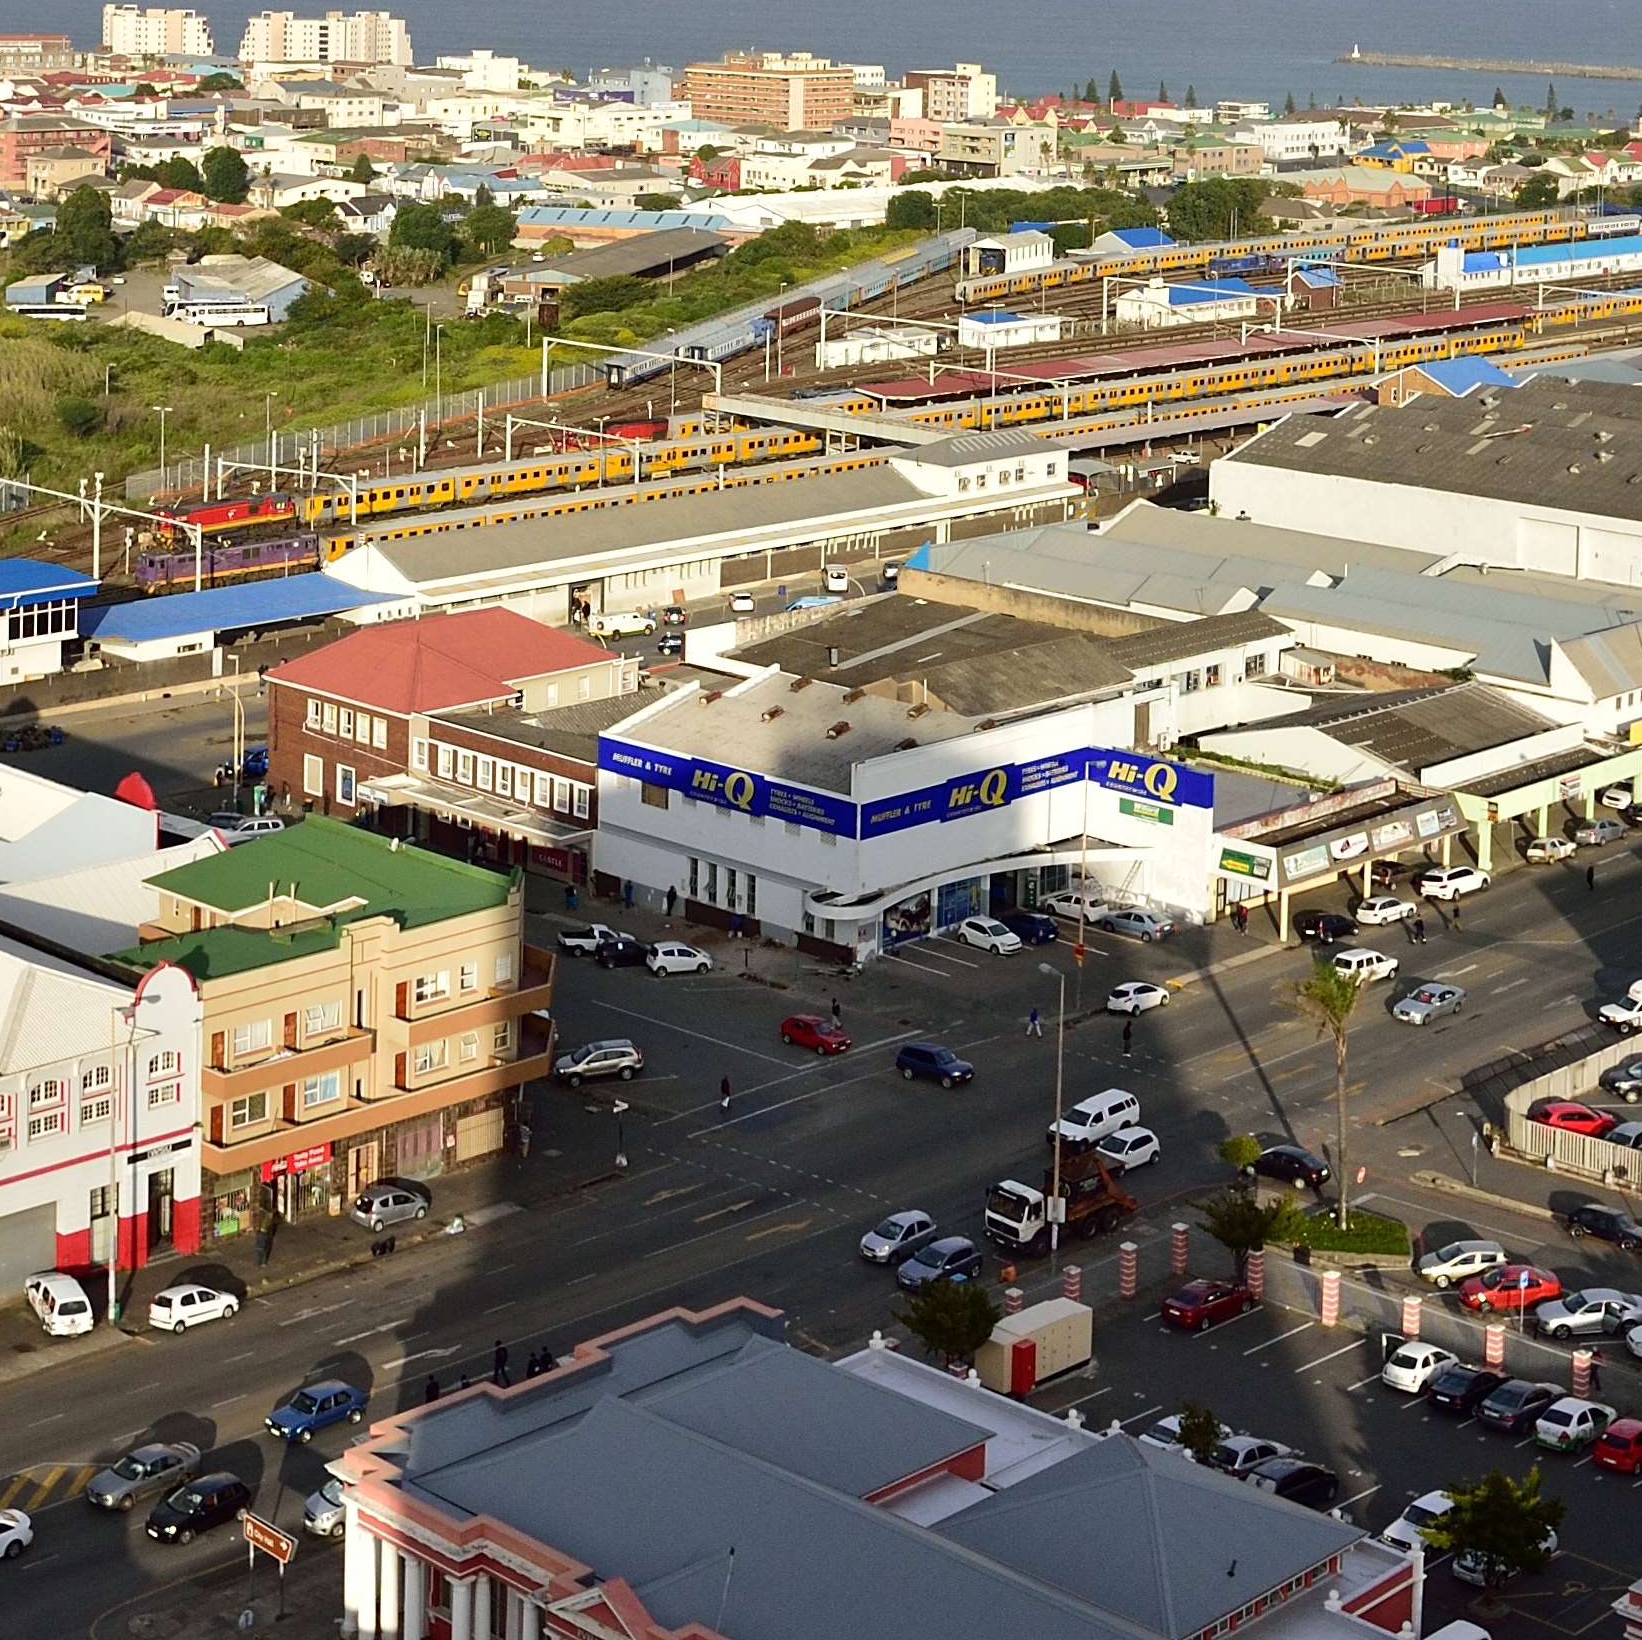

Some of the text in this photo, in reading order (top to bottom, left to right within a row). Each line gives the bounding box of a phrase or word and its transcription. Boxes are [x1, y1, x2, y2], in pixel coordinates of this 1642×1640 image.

[654, 763, 673, 776] TYRE
[948, 769, 1007, 808] Hi-Q
[1108, 760, 1177, 802] Hi-Q
[692, 769, 755, 810] Hi-Q
[913, 799, 932, 813] TYRE
